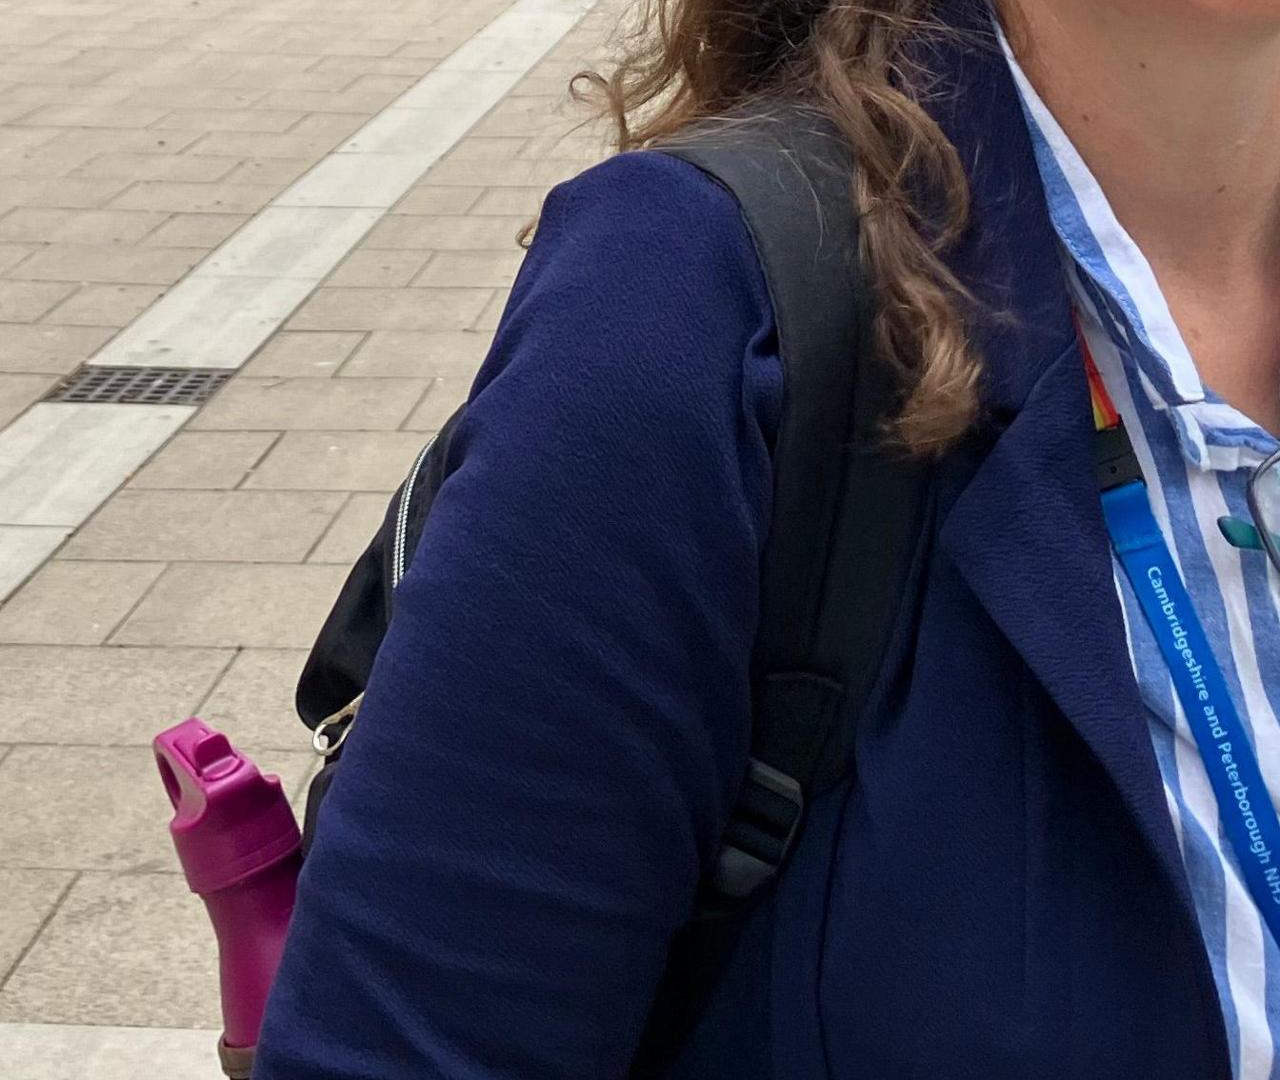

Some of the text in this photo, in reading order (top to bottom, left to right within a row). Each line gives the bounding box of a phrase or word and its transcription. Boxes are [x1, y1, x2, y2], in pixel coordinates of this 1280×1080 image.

[1147, 566, 1209, 701] Cambridgeshire
[1204, 705, 1227, 738] and
[1218, 742, 1272, 864] Peterborough
